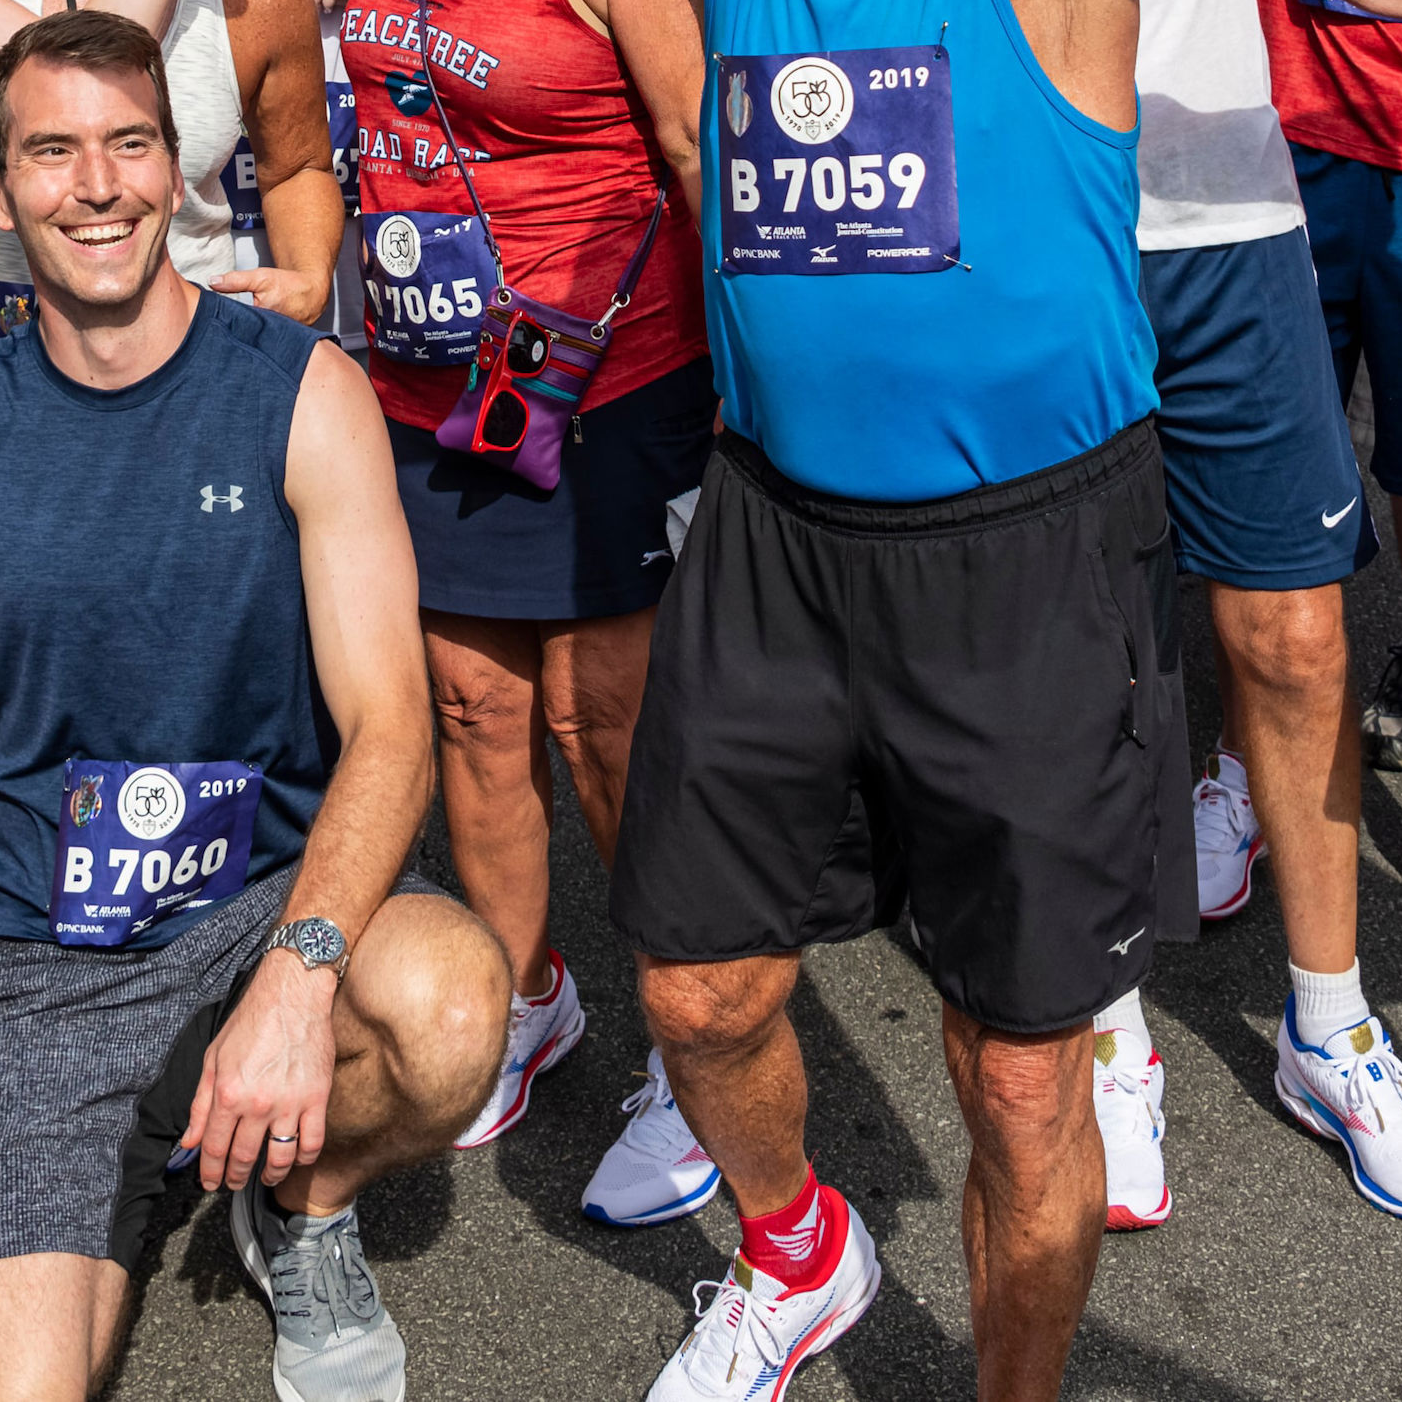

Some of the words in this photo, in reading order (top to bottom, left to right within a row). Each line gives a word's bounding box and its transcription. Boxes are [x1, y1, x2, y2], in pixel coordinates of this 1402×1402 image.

[869, 66, 930, 91] 2019
[731, 158, 761, 213] B
[773, 152, 926, 213] 7059
[773, 226, 806, 235] ATLANTA
[384, 277, 483, 325] 7065
[199, 778, 247, 798] 2019
[63, 846, 94, 893] B
[108, 837, 228, 895] 7060
